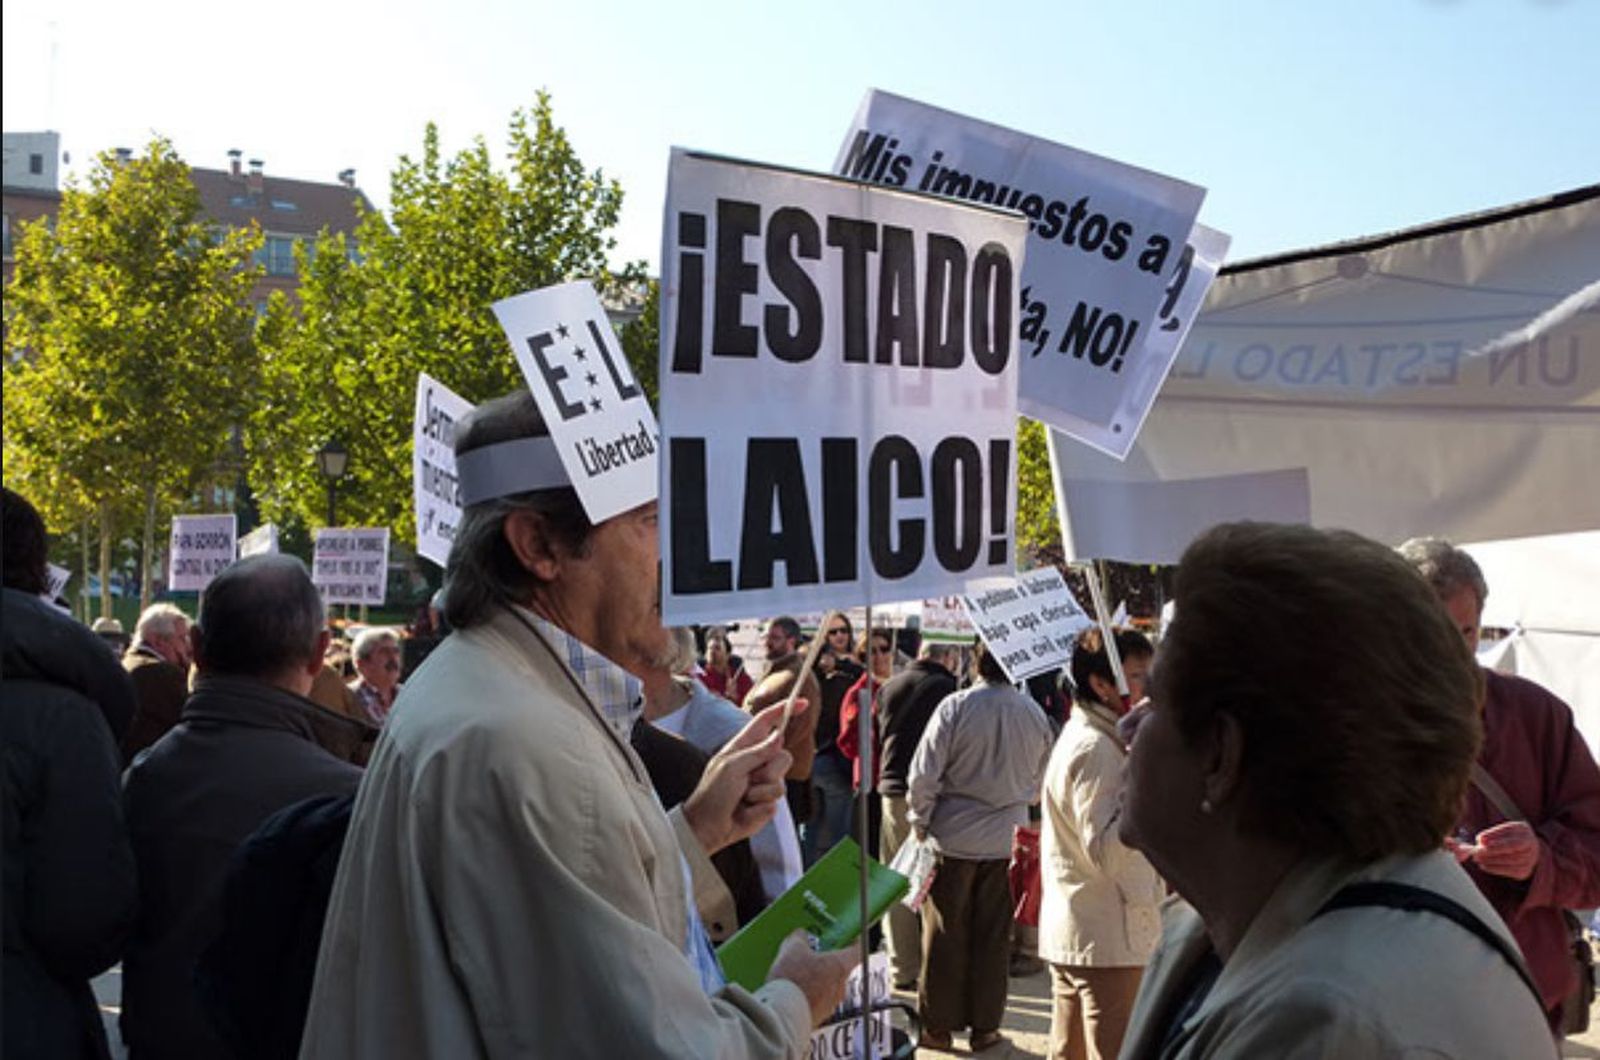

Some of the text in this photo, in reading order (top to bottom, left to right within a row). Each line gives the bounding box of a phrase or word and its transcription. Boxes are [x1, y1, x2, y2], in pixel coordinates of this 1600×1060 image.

[842, 128, 913, 187] Mis
[1138, 234, 1171, 275] a
[671, 198, 1013, 376] ¡ESTADO
[526, 331, 587, 421] E
[1058, 301, 1139, 373] NO!
[573, 418, 656, 478] Libertad
[669, 434, 1011, 596] LAICO!
[980, 623, 1010, 642] bajo
[1011, 612, 1040, 632] capa
[1001, 649, 1031, 672] pena
[1032, 636, 1056, 658] civil
